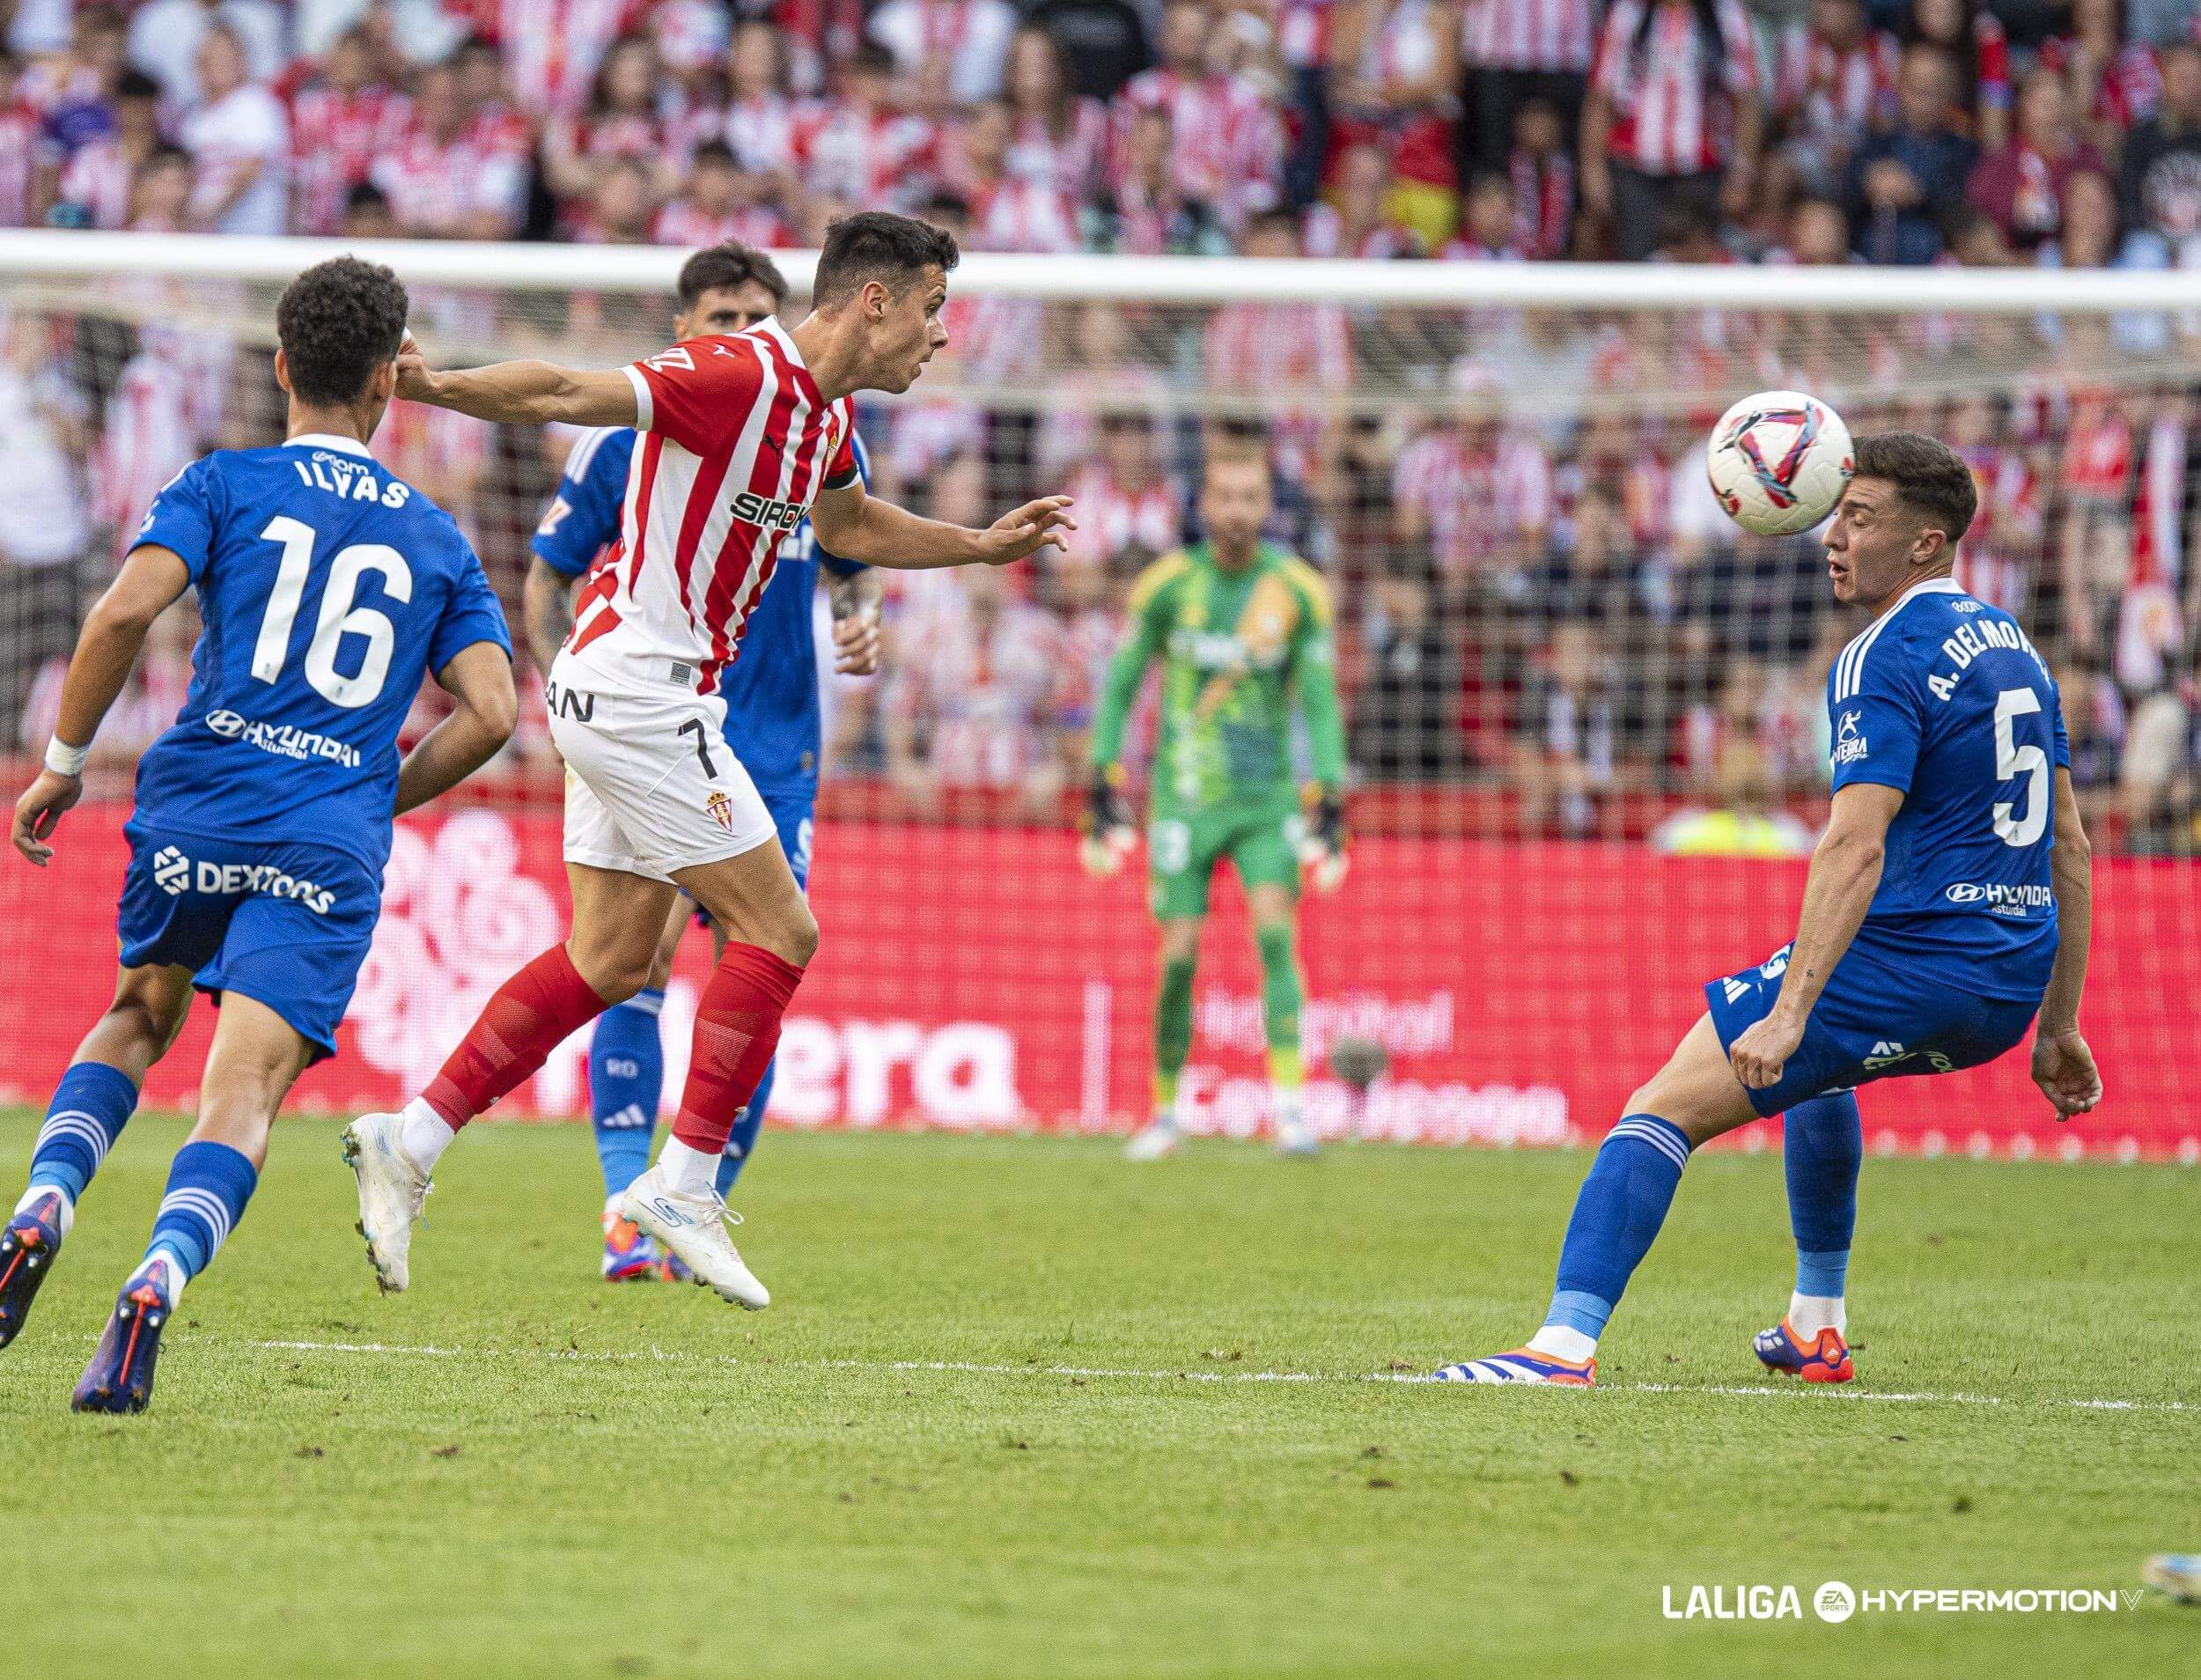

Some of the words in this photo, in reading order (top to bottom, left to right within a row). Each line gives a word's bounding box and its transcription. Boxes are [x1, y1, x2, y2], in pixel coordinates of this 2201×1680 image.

[294, 461, 410, 508] ILYAS
[729, 491, 813, 530] SIROK
[250, 515, 413, 708] 16
[1941, 619, 2053, 691] DELMO
[1927, 673, 1961, 702] A.
[241, 720, 361, 769] HYUNDAI
[1992, 688, 2050, 847] 5
[1986, 883, 2051, 907] HYUNDA
